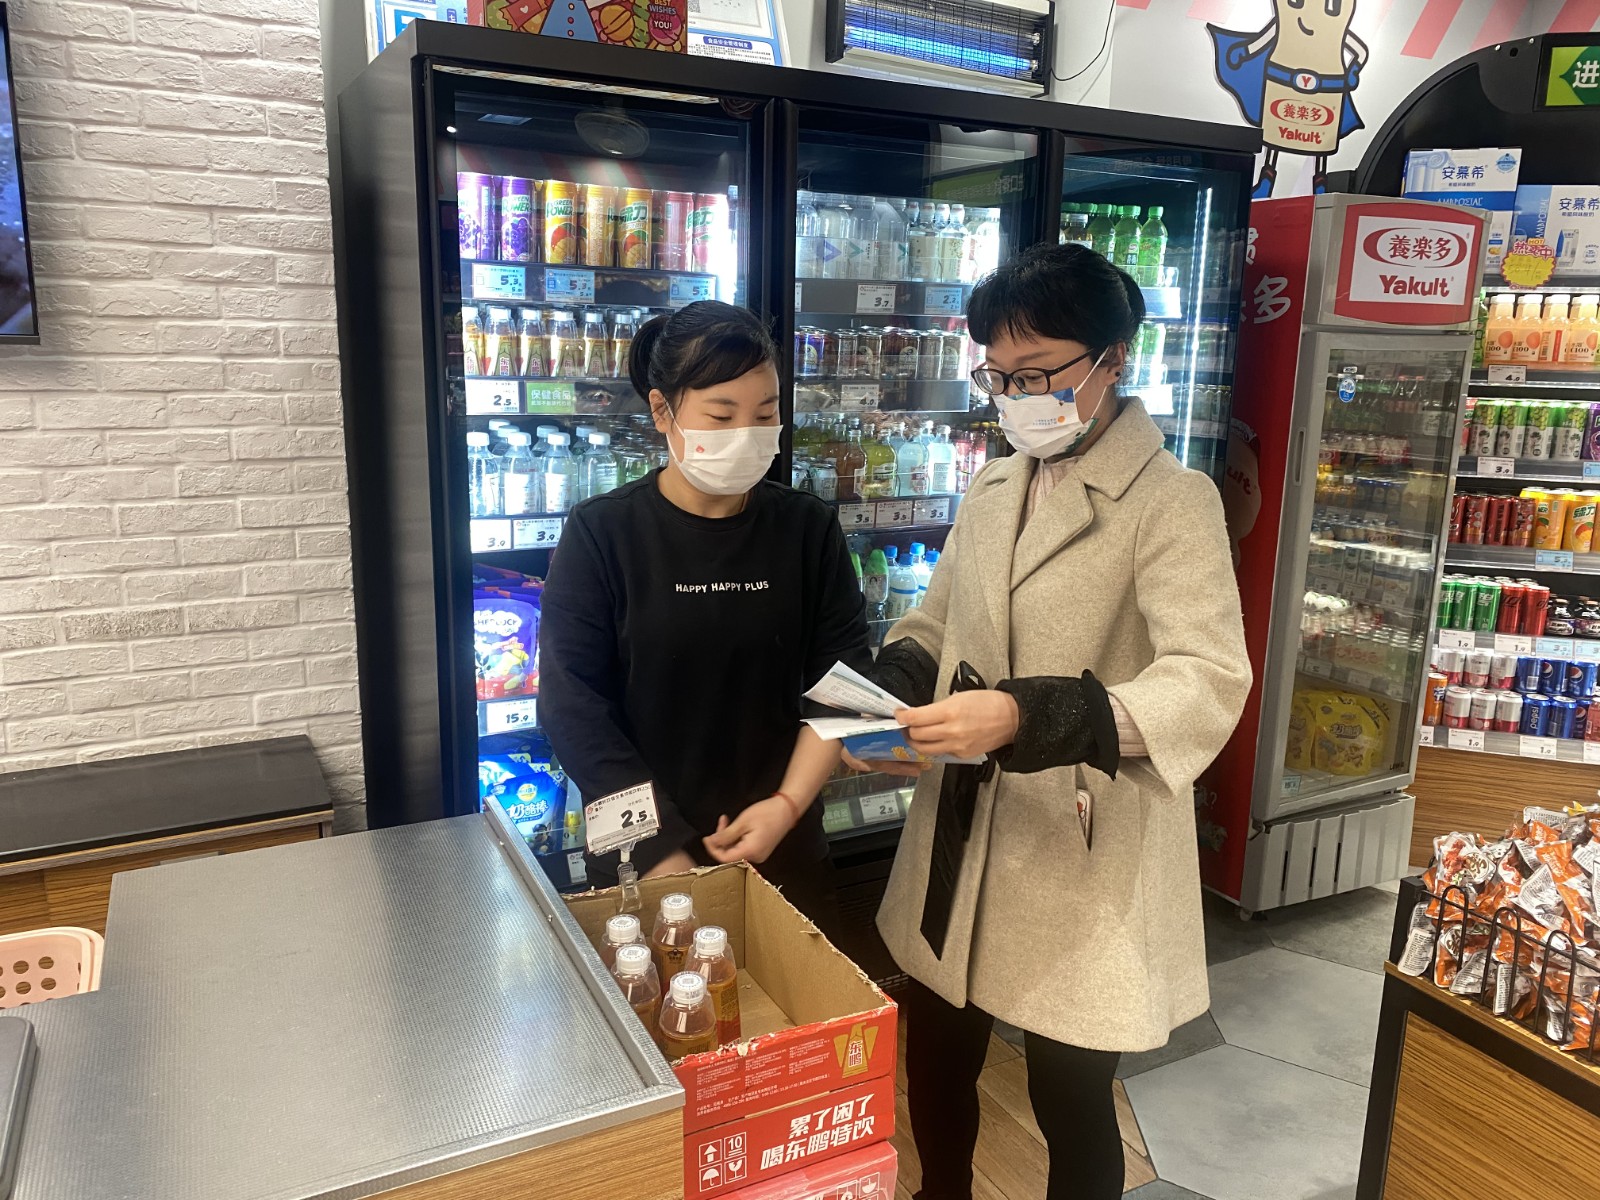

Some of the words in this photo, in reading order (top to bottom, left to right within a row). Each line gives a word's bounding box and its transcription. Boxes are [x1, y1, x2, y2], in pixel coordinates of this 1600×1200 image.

[649, 5, 677, 15] WISHES
[654, 20, 672, 29] YOU!
[1300, 75, 1312, 88] Y
[1572, 60, 1600, 89] 进
[1282, 103, 1324, 122] 養楽多
[1278, 126, 1321, 145] Yakult
[1441, 165, 1485, 180] 安慕希
[1558, 197, 1600, 211] 安慕希
[1388, 235, 1452, 262] 養楽多
[1379, 274, 1450, 299] Yakult
[873, 297, 890, 308] 3.7
[1240, 274, 1291, 324] 多
[493, 395, 512, 406] 2.5
[531, 389, 571, 400] 保健食品
[675, 583, 707, 593] HAPPY
[711, 582, 741, 592] HAPPY
[744, 580, 769, 591] PLUS
[506, 713, 529, 724] 15.9
[1530, 706, 1540, 729] pepsi
[508, 799, 549, 819] 奶酪棒
[620, 809, 648, 829] 2.5
[848, 1041, 863, 1068] 东鹏
[788, 1093, 875, 1140] 累了困了
[728, 1135, 743, 1151] 10
[760, 1116, 875, 1171] 喝东鹏特饮
